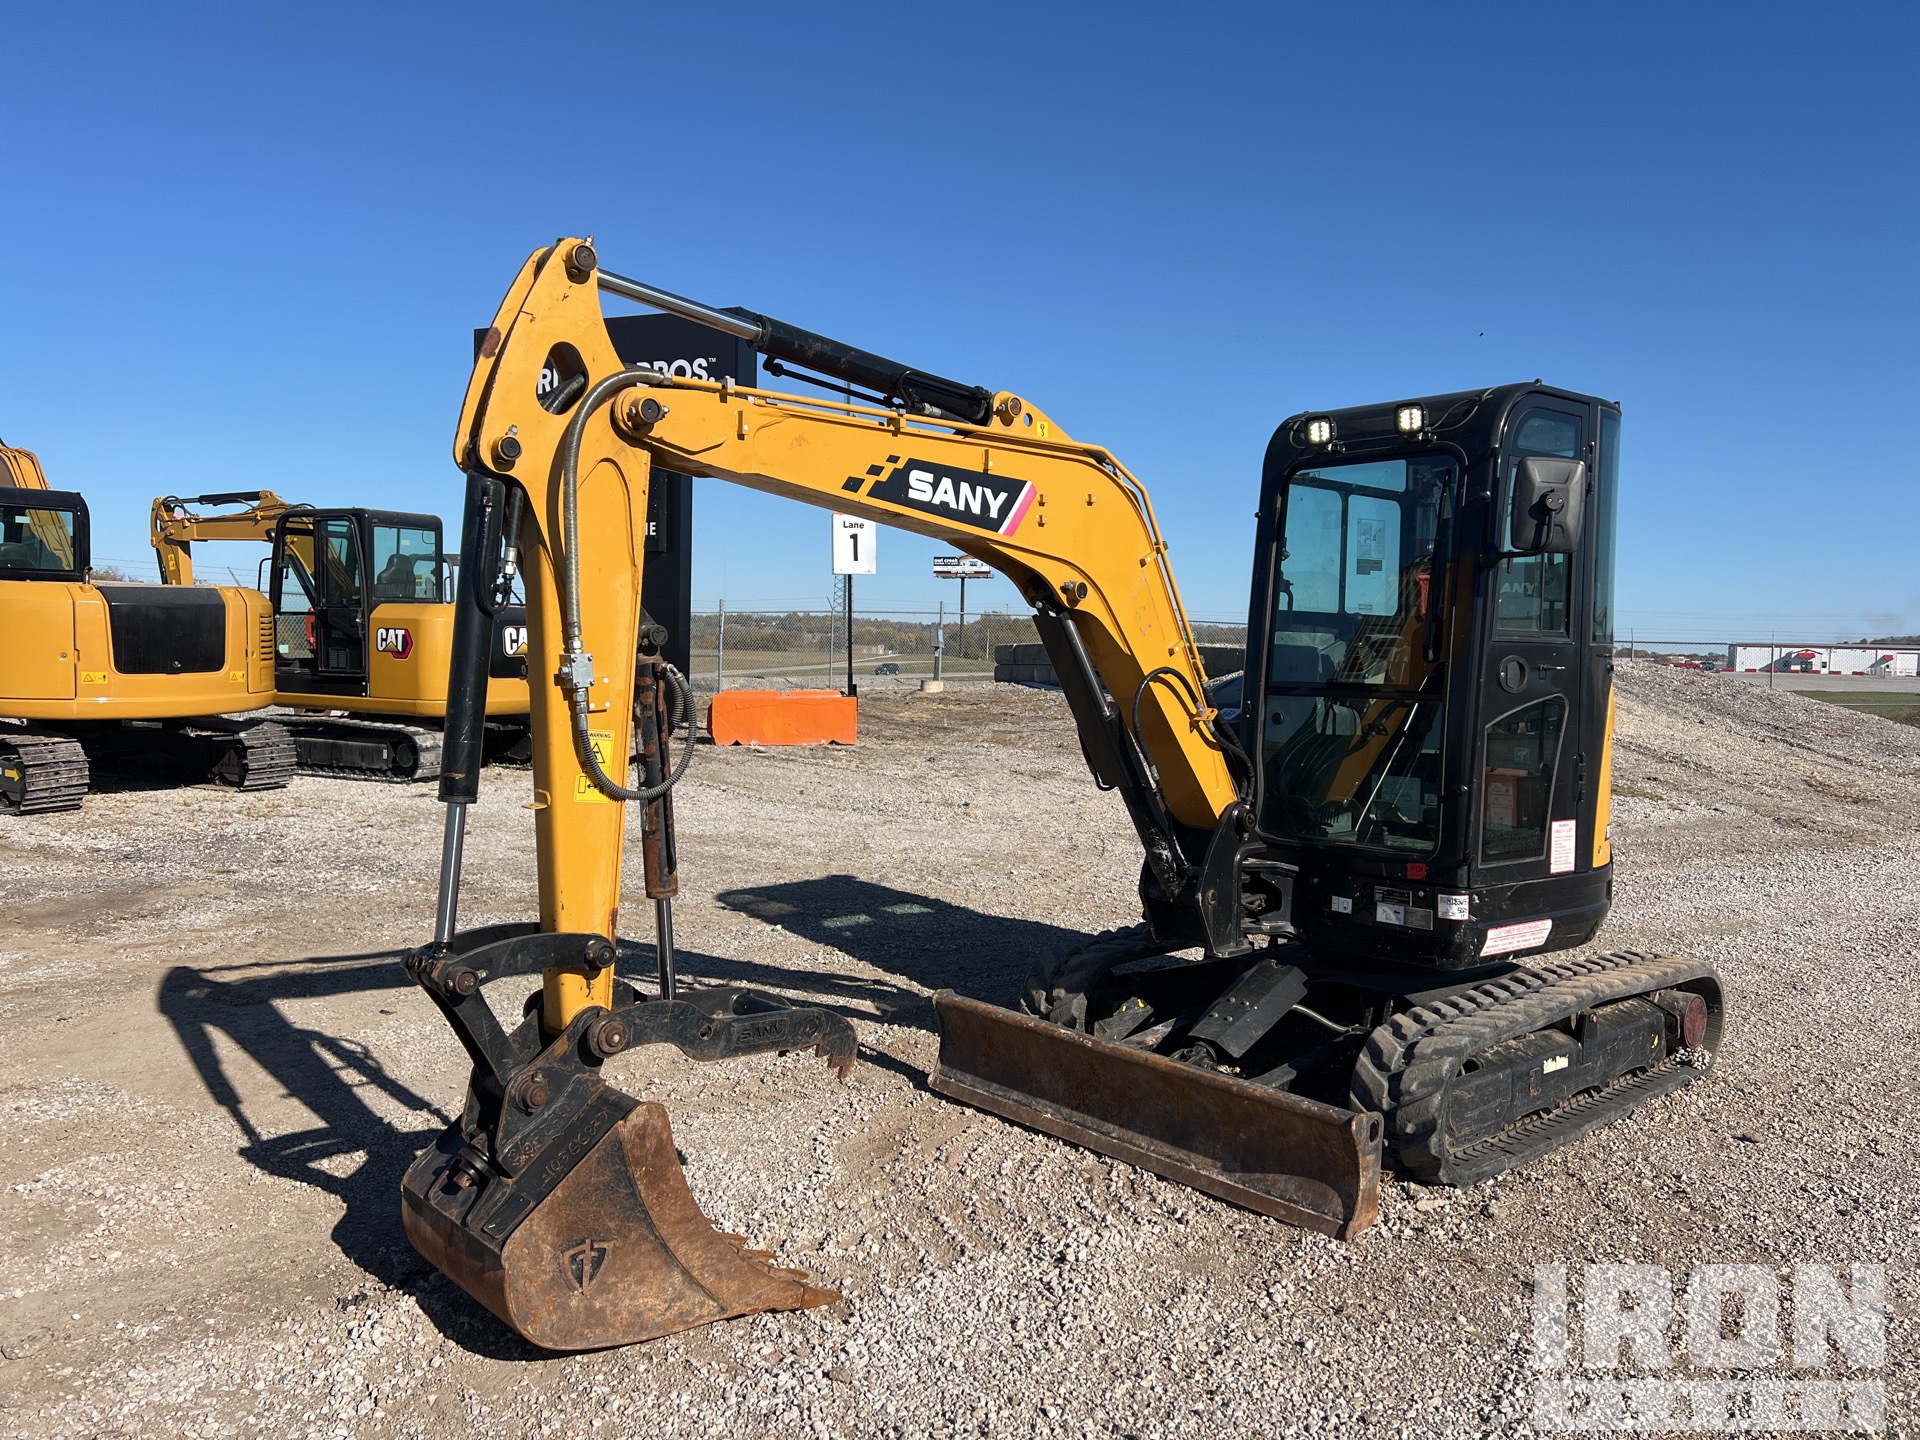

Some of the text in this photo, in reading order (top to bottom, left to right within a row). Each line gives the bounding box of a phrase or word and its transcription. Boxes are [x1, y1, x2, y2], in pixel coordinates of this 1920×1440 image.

[907, 469, 1008, 519] SANY
[842, 520, 865, 529] Lane
[849, 533, 859, 561] 1
[1499, 582, 1535, 595] ANY
[377, 628, 405, 651] CAT
[504, 627, 528, 655] CA
